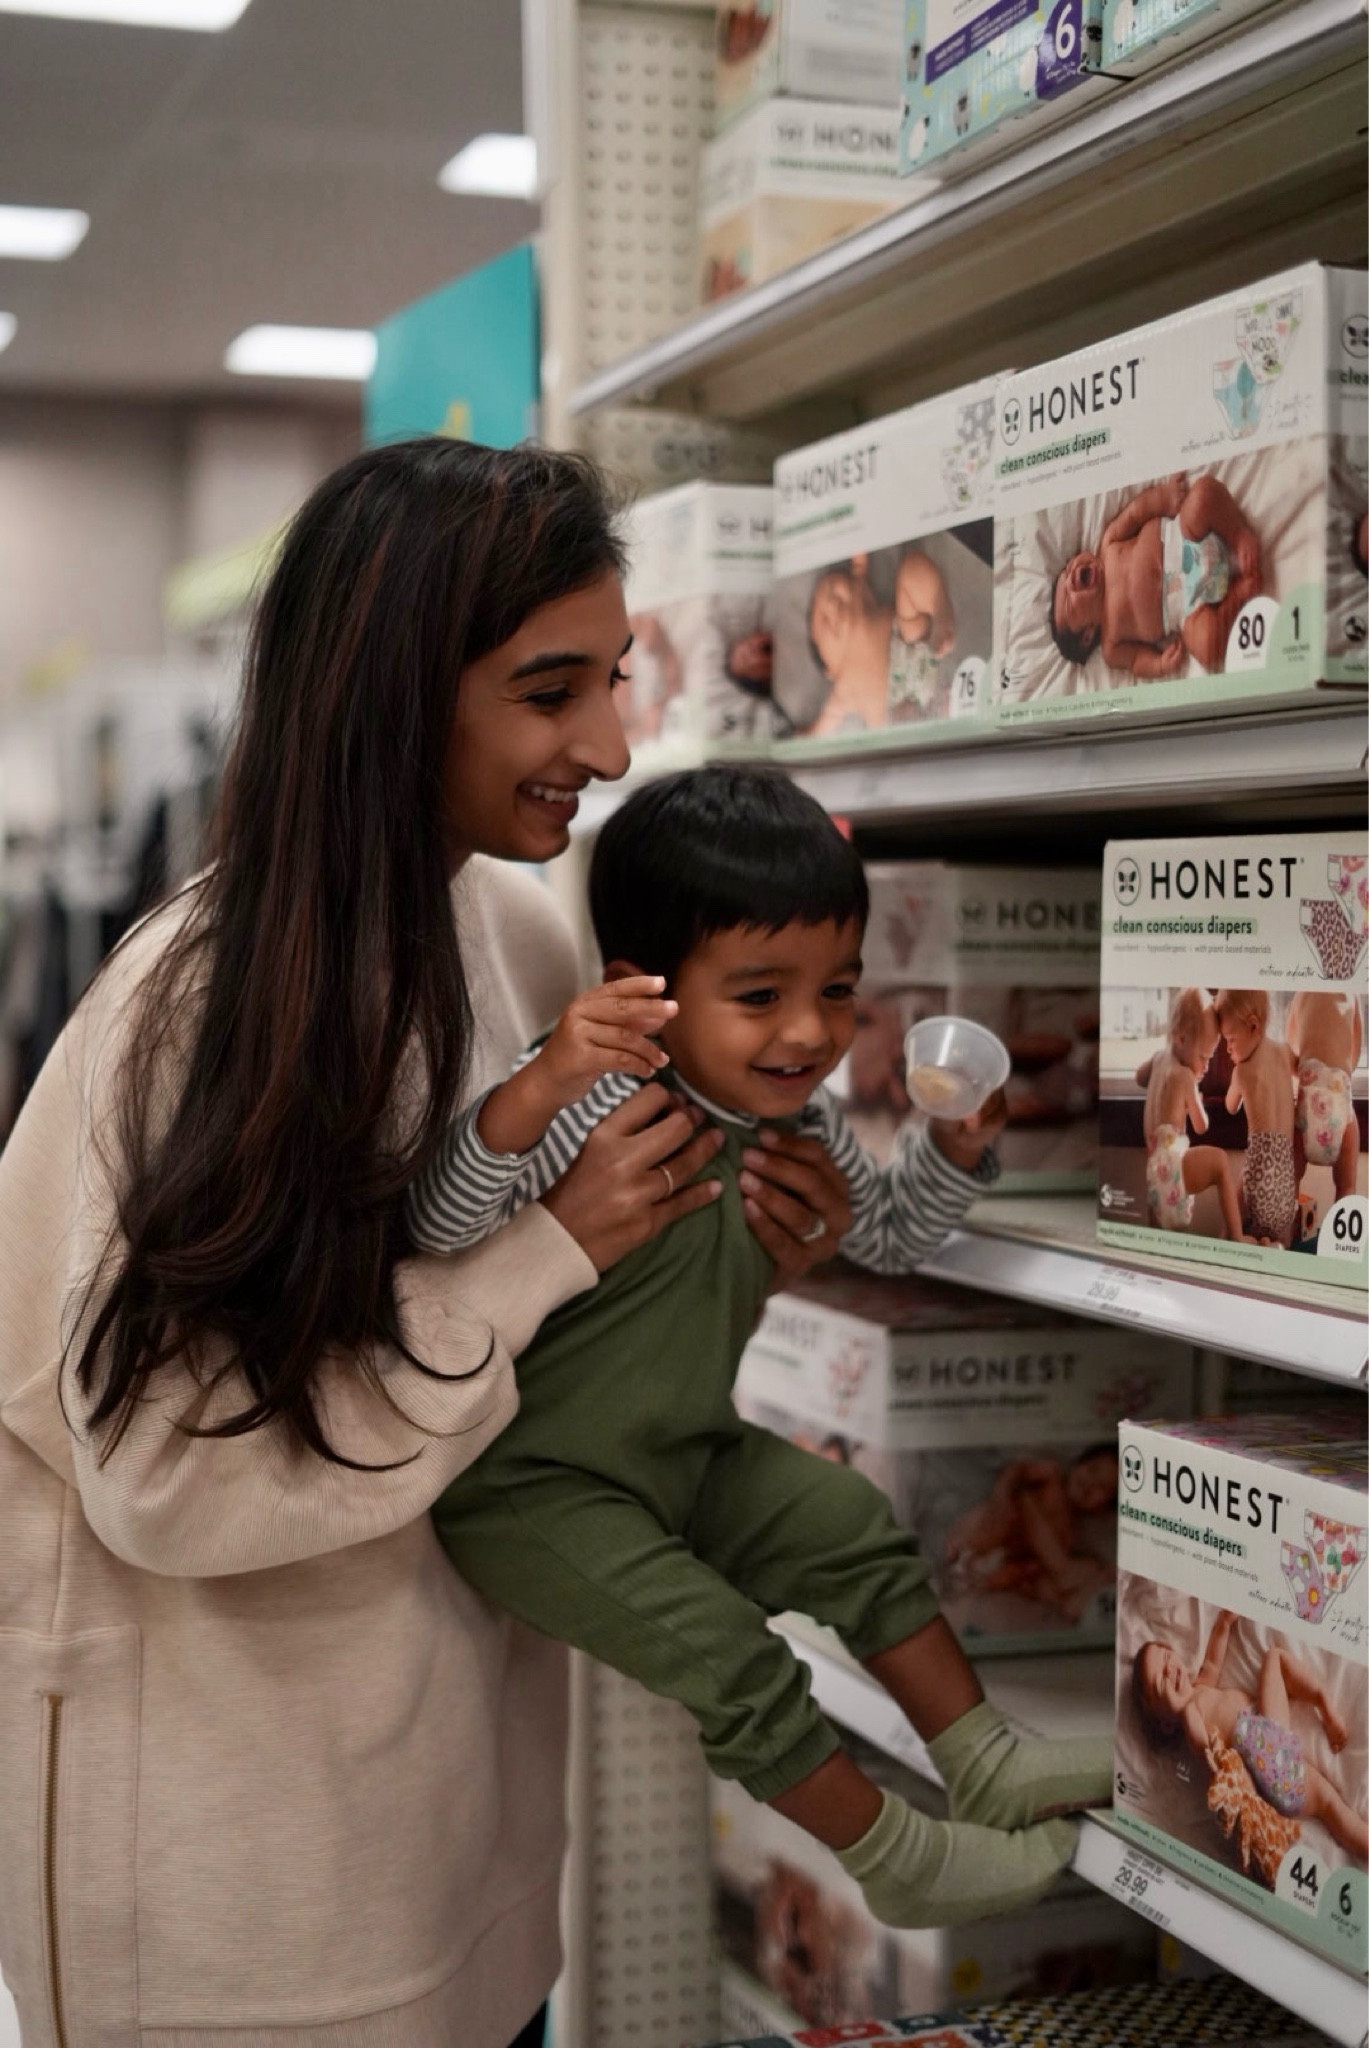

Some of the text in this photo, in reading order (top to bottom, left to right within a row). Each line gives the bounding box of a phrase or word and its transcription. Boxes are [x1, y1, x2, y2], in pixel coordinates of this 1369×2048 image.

[1055, 3, 1076, 59] 6
[1029, 358, 1140, 432] HONEST
[1001, 456, 1024, 474] clean
[1027, 442, 1070, 467] conscious
[1072, 431, 1106, 456] diapers
[797, 446, 877, 499] HONEST
[1238, 612, 1265, 649] 80
[1292, 606, 1299, 640] 1
[960, 671, 974, 698] 76
[1151, 857, 1297, 899] HONEST
[1113, 914, 1252, 940] clean conscious diapers
[1333, 1208, 1363, 1242] 60
[1335, 1243, 1360, 1254] DIAPERS
[929, 1353, 1075, 1386] HONEST
[1153, 1457, 1283, 1534] HONEST
[1119, 1500, 1147, 1523] clean
[1150, 1513, 1200, 1542] conscious
[1202, 1527, 1242, 1557] diapers
[1115, 1866, 1148, 1896] 29.99
[1290, 1856, 1318, 1897] 44
[1339, 1882, 1352, 1916] 6
